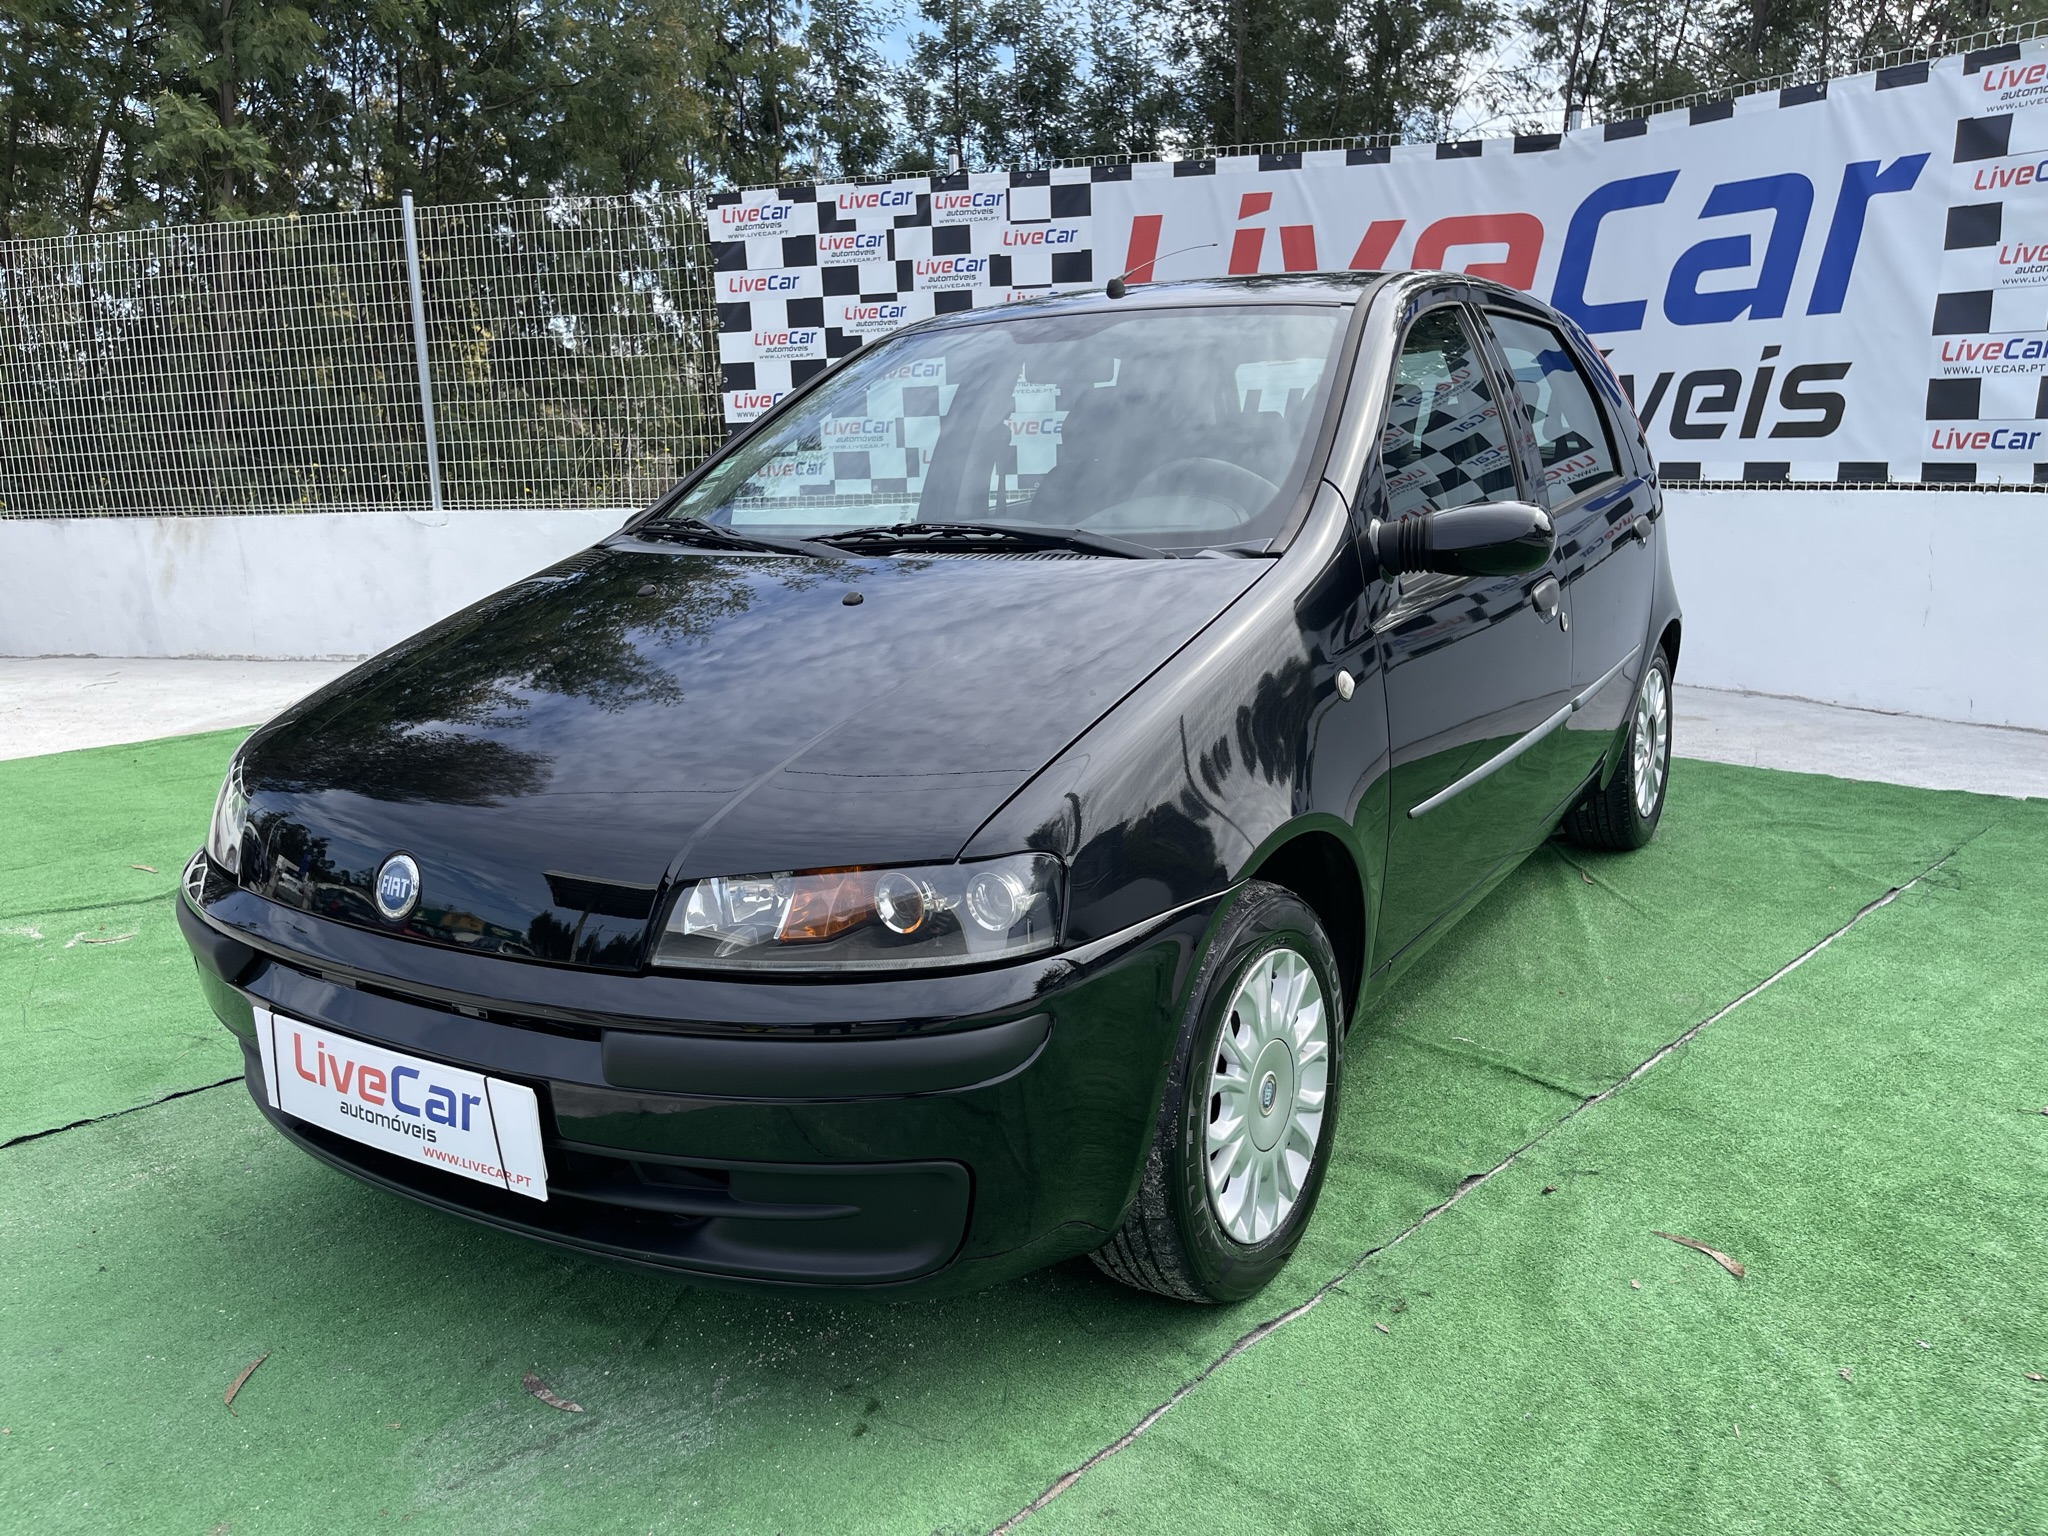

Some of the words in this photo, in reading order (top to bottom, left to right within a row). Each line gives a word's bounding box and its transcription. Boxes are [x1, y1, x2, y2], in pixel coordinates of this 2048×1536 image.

[839, 190, 913, 210] LiveCar
[935, 193, 1004, 210] LiveCar
[722, 205, 792, 223] LiveCar
[939, 216, 1000, 224] WWW.LIVECAR.PT
[946, 207, 994, 217] automóveis
[727, 230, 789, 239] WWW.LIVECAR.PT
[735, 221, 782, 232] automóveis
[819, 234, 885, 250] LiveCar
[1003, 228, 1079, 246] LiveCar
[831, 249, 876, 258] automóveis
[916, 257, 987, 275] LiveCar
[728, 275, 800, 293] LiveCar
[920, 282, 983, 290] WWW.LIVECAR.PT
[928, 273, 977, 283] automóveis
[844, 305, 907, 320] LiveCar
[856, 319, 898, 327] automóveis
[754, 331, 818, 346] LiveCar
[765, 345, 809, 353] automóveis
[1943, 364, 2046, 375] WWW.LIVECAR.PT
[734, 393, 783, 408] LiveC
[823, 419, 894, 436] LiveCar
[1931, 427, 2042, 450] LiveCar
[757, 461, 827, 478] LiveCar
[381, 875, 411, 899] FIAT
[293, 1032, 482, 1132] LiveCar
[340, 1100, 437, 1144] automóveis
[422, 1145, 532, 1188] WWW.LIVECAR.PT
